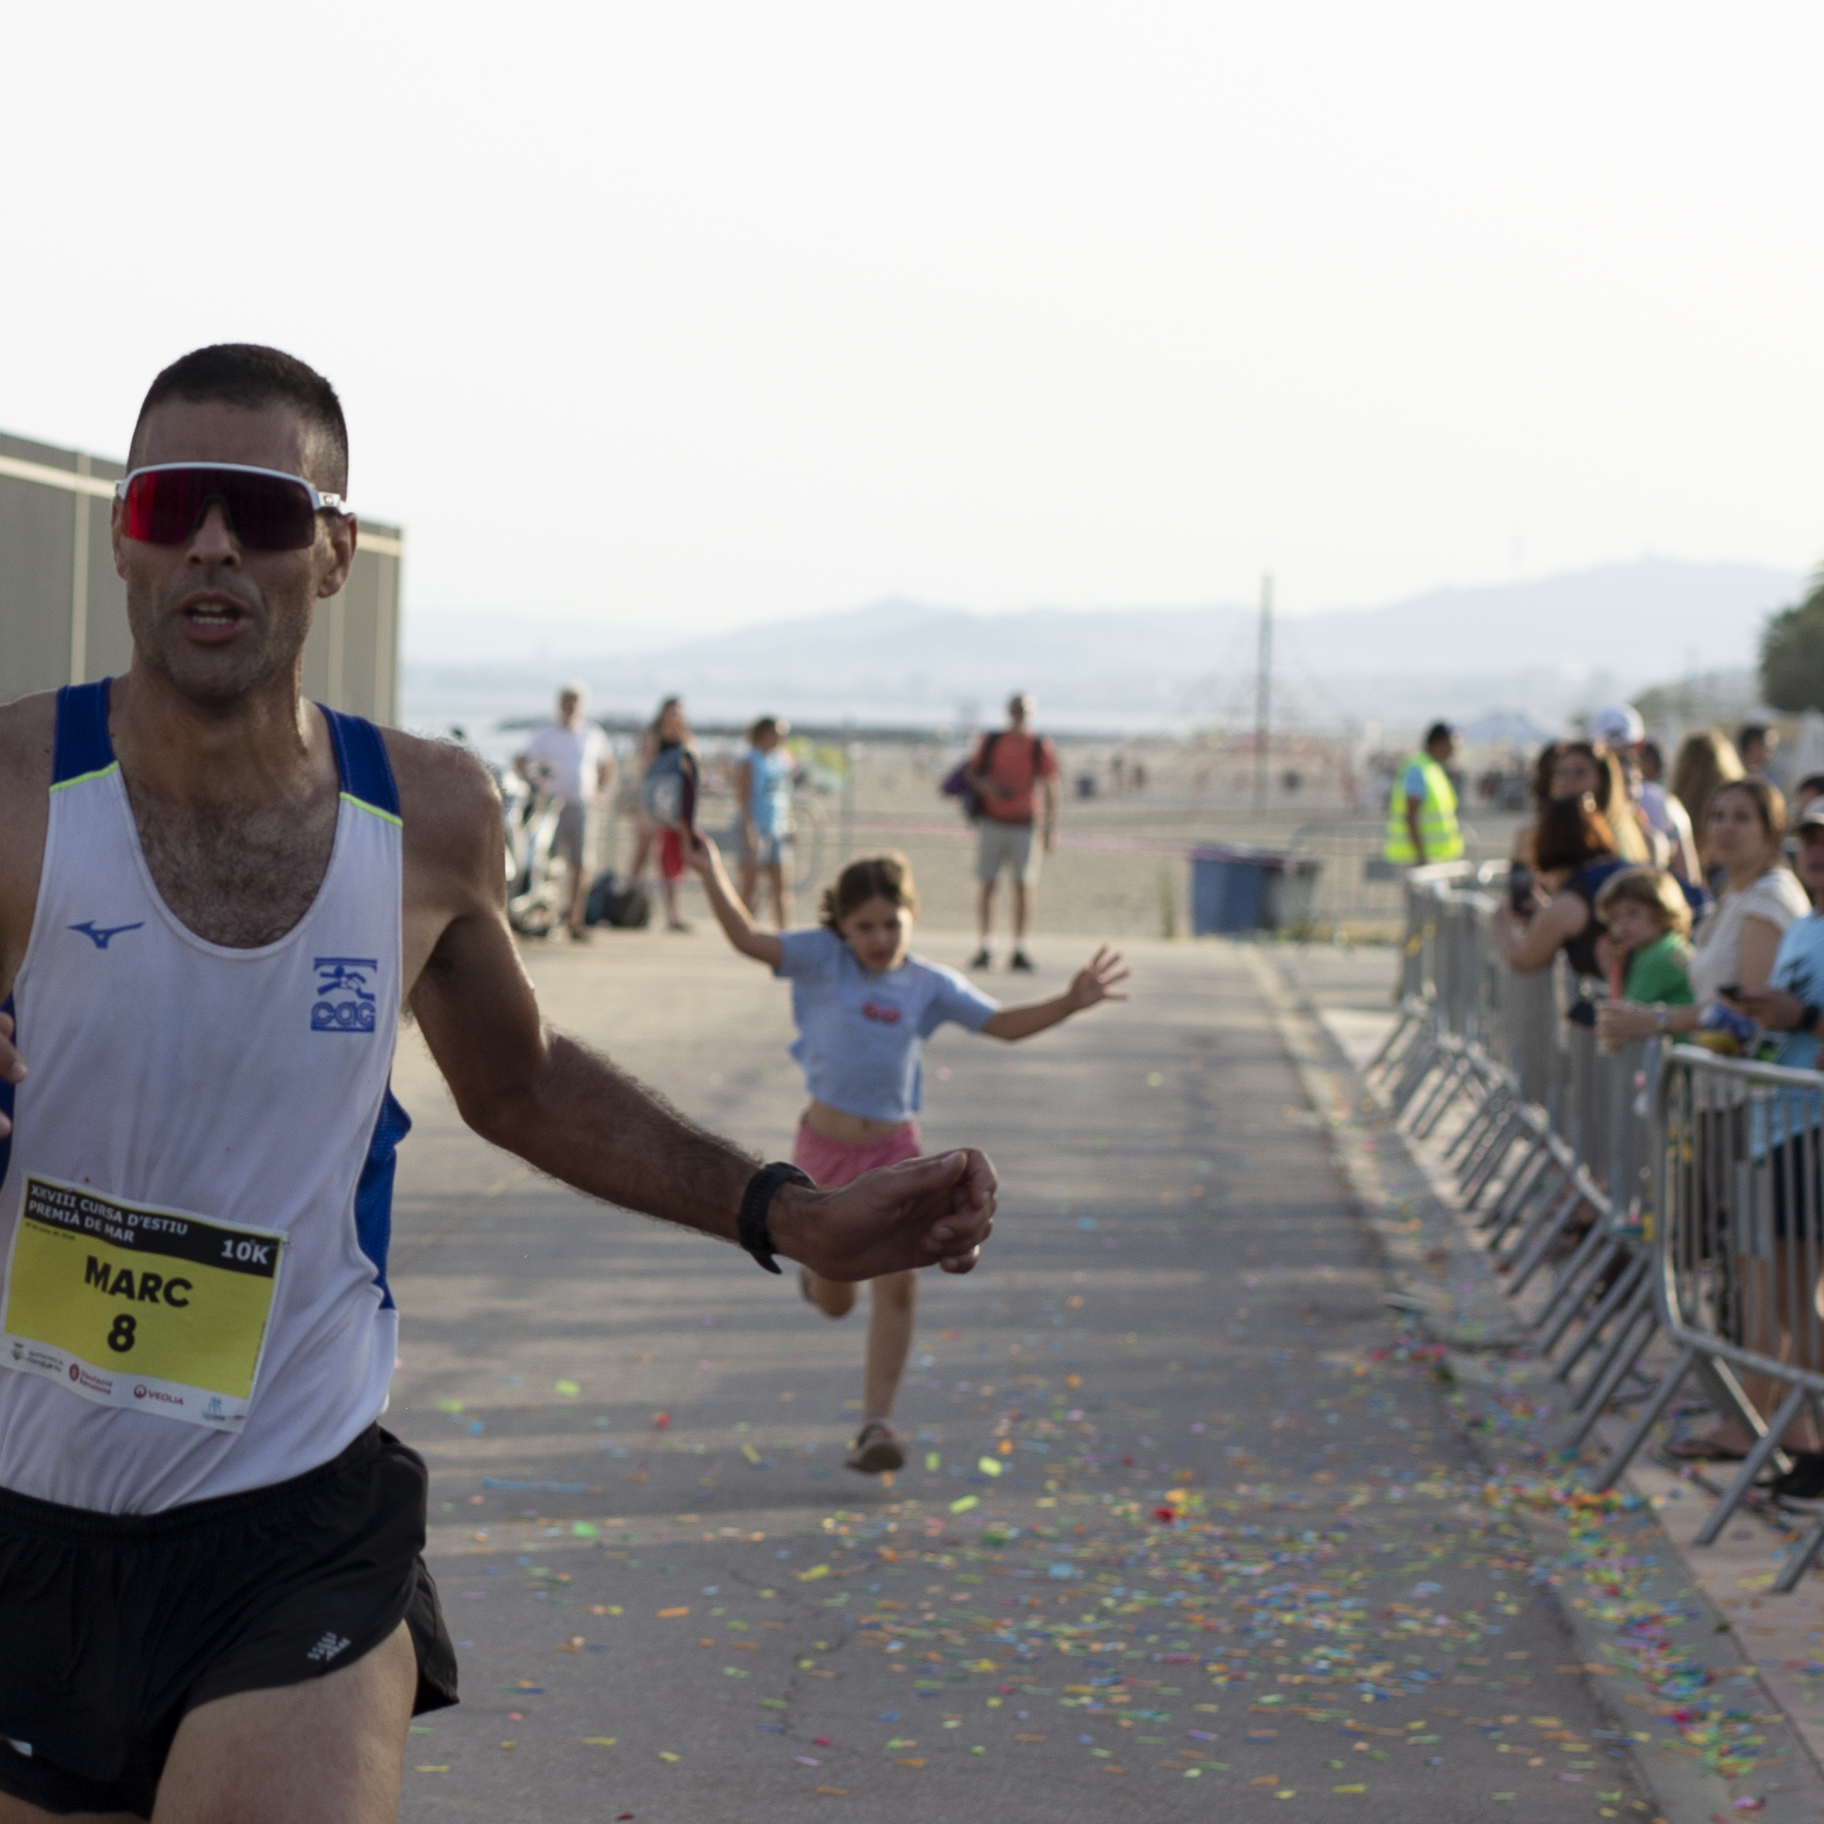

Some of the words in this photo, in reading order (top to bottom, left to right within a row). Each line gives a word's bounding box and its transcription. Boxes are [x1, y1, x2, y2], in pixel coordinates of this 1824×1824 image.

[28, 1200, 80, 1227] PREMIÀ
[84, 1215, 104, 1233] DE
[105, 1222, 135, 1244] MAR
[31, 1184, 76, 1208] XXVIII
[80, 1198, 124, 1223] CURSA
[221, 1239, 271, 1265] 10K
[84, 1254, 194, 1308] MARC
[107, 1313, 137, 1353] 8
[148, 1389, 184, 1406] VEOLIA
